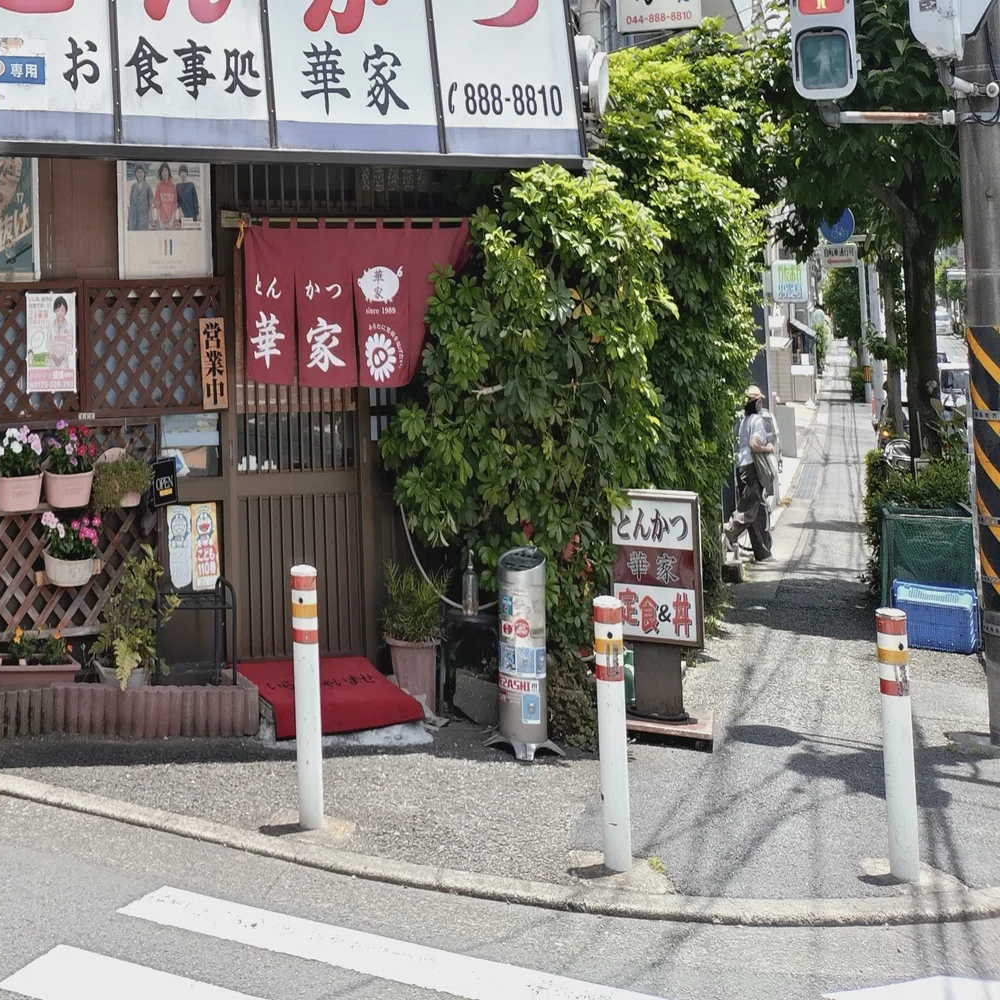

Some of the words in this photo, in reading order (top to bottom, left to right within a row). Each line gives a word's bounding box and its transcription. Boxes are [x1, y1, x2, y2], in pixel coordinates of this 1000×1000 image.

[625, 10, 692, 25] 044-888-8810
[63, 36, 262, 99] お食事処
[302, 43, 410, 115] 華家
[464, 83, 562, 116] 888-8810
[255, 273, 342, 300] とんかつ
[373, 269, 384, 299] 華家
[381, 306, 396, 314] 1989
[250, 311, 346, 372] 華家
[203, 322, 224, 405] 営業中
[155, 475, 174, 491] OPEN
[617, 507, 688, 542] とんかつ
[197, 547, 215, 561] こども
[627, 551, 679, 584] 華家
[619, 588, 692, 638] 定食&丼
